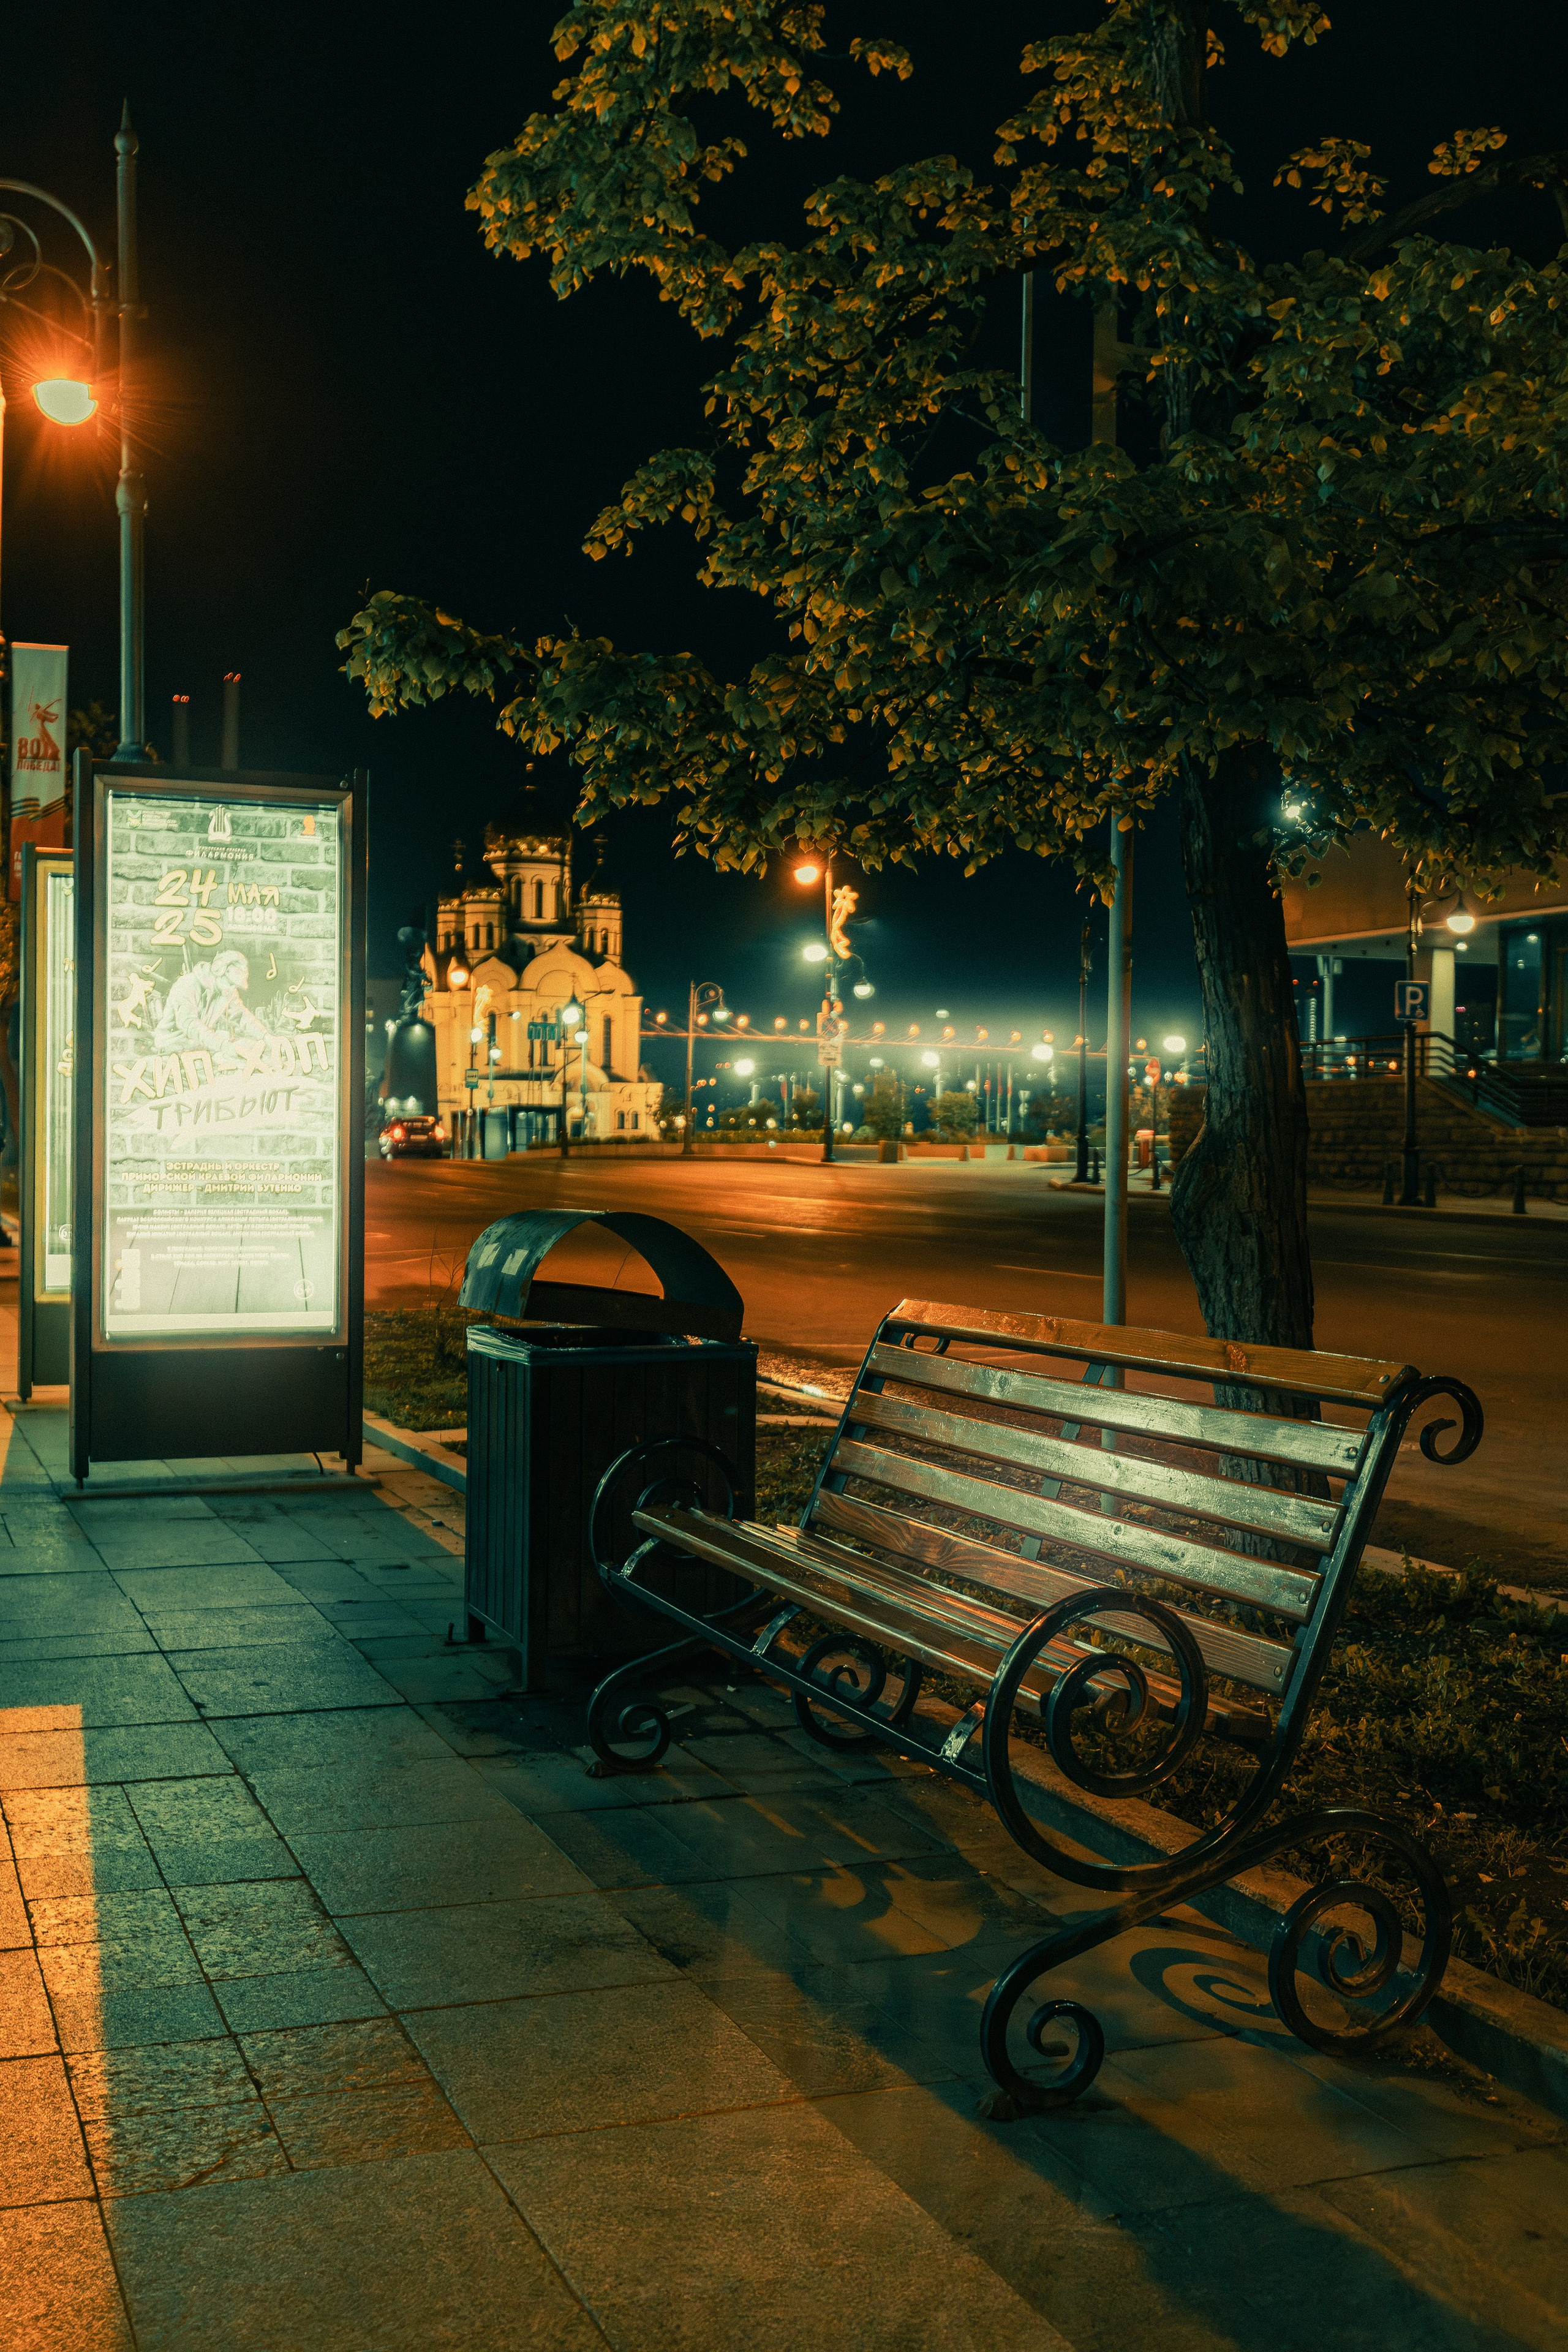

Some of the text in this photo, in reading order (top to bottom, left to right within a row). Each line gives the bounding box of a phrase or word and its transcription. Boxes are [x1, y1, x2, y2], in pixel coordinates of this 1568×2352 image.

[17, 737, 40, 759] 80
[186, 850, 254, 861] ФИЛАРМОНИЯ
[154, 869, 280, 908] 24 МАЯ
[150, 908, 223, 946] 25
[1406, 987, 1424, 1015] P
[113, 1032, 329, 1104] ХИП-ХОП
[149, 1086, 299, 1129] ТРИБЬЮТ
[121, 1170, 195, 1181] ПРИМОРСКОЙ
[198, 1170, 246, 1181] КРАЕВОЙ
[166, 1160, 280, 1171] ЭСТРАДНЫЙ ОРКЕСТР
[143, 1183, 195, 1194] ДИРИЖЕР
[257, 1184, 303, 1193] БУТЕНКО
